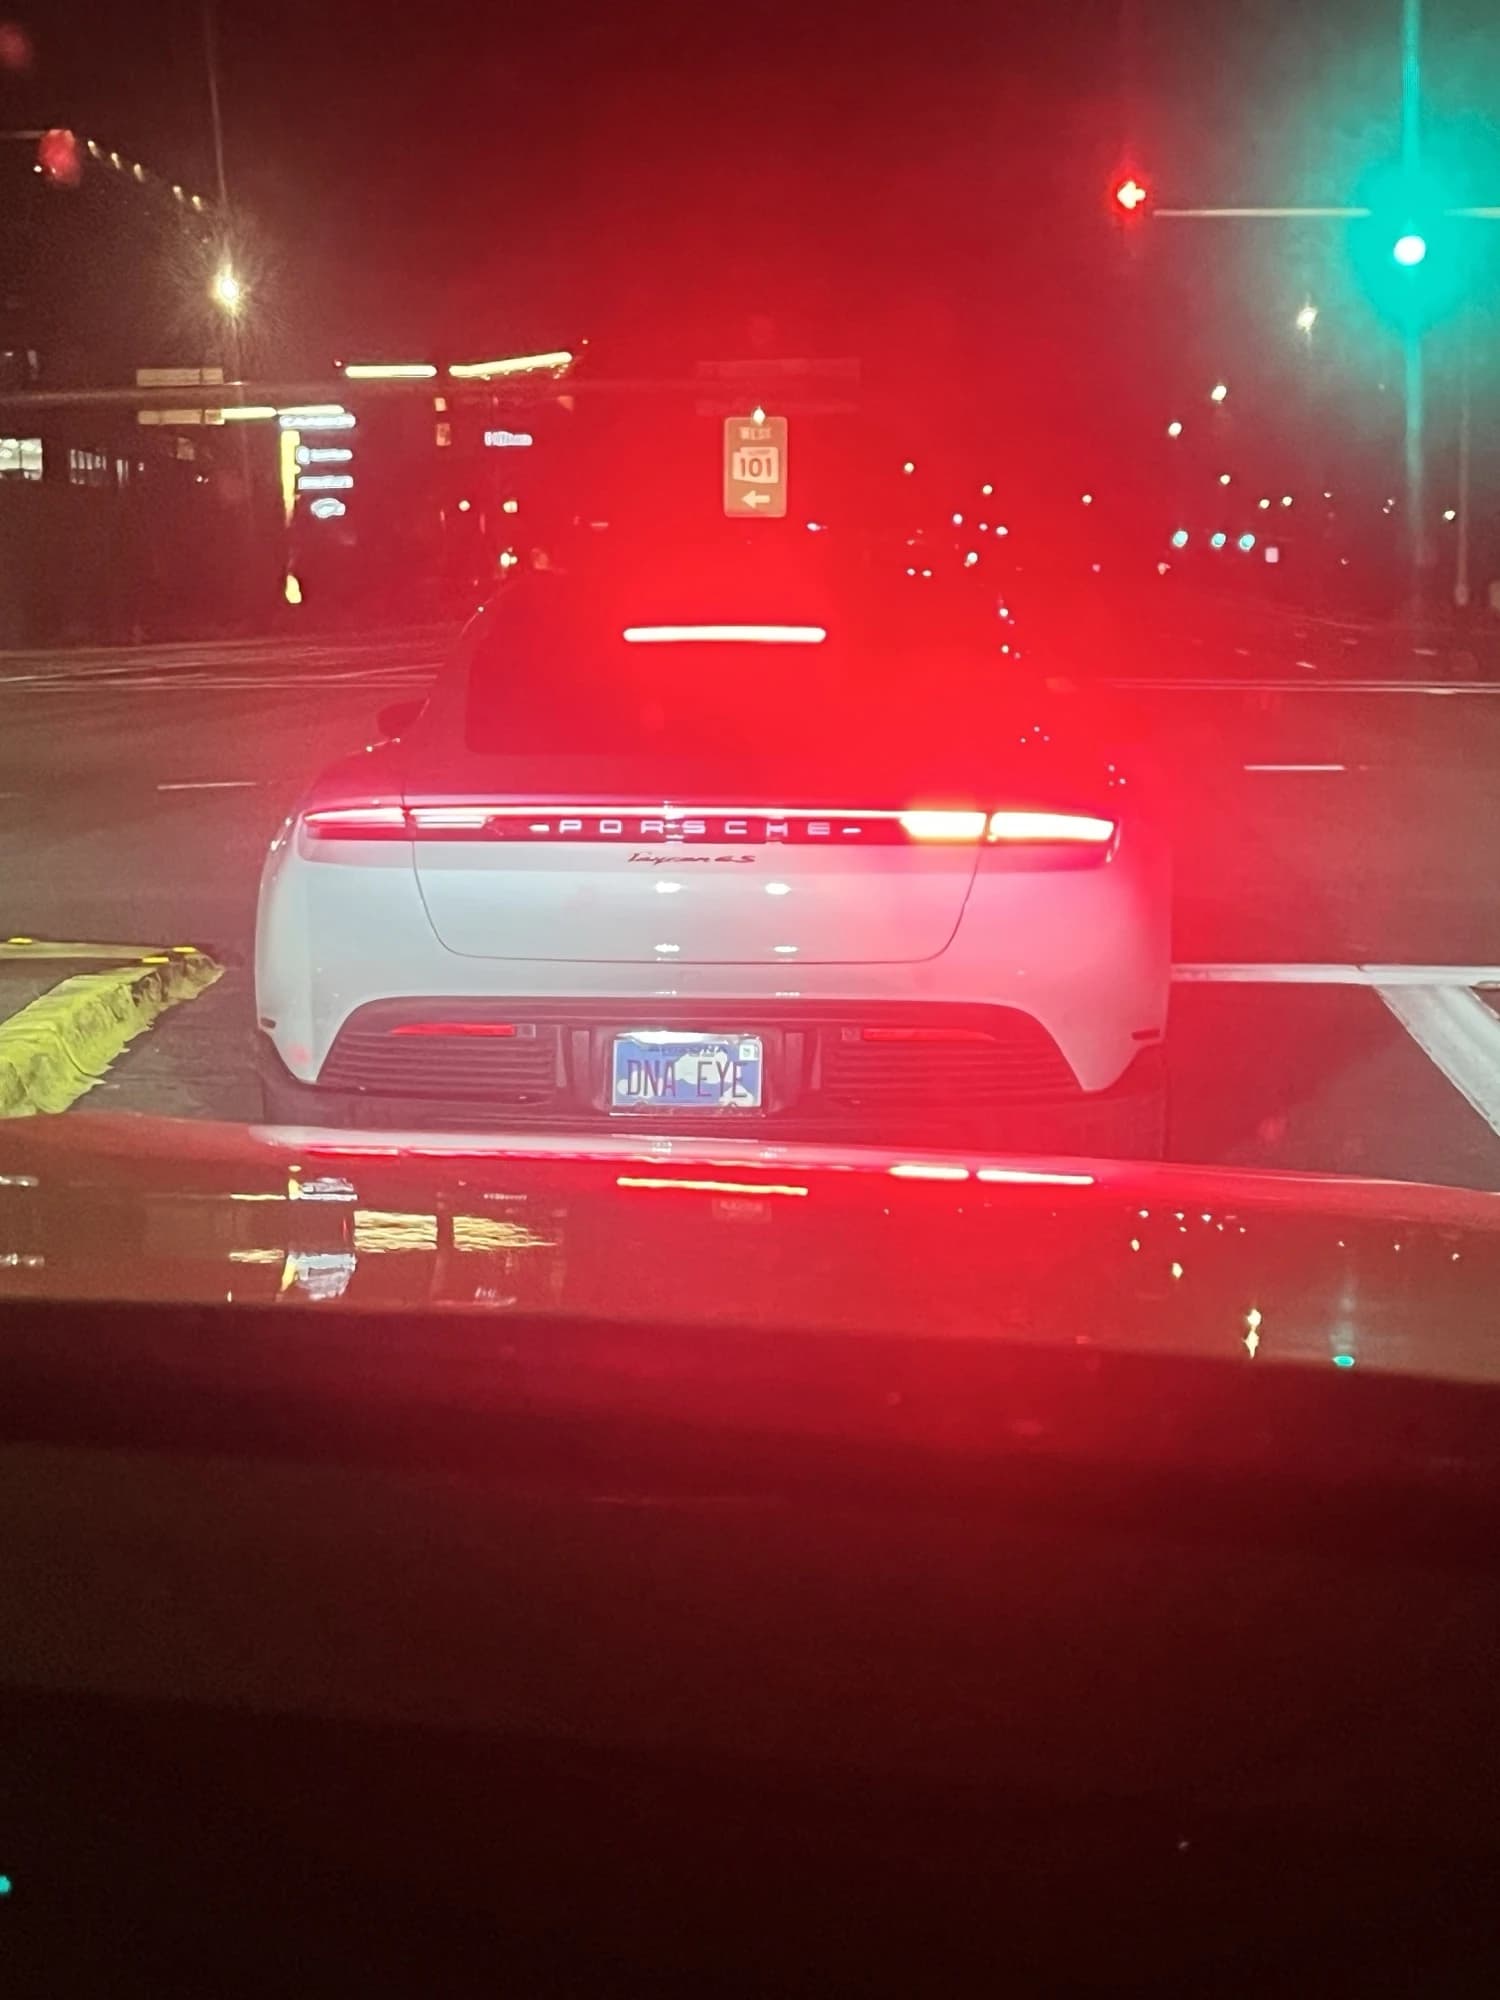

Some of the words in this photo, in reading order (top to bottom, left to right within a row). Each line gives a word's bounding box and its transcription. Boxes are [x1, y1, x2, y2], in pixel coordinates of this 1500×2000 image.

[740, 457, 772, 478] 101
[559, 819, 831, 837] PORSCHE
[626, 1060, 677, 1097] DNA
[697, 1061, 748, 1098] EYE
